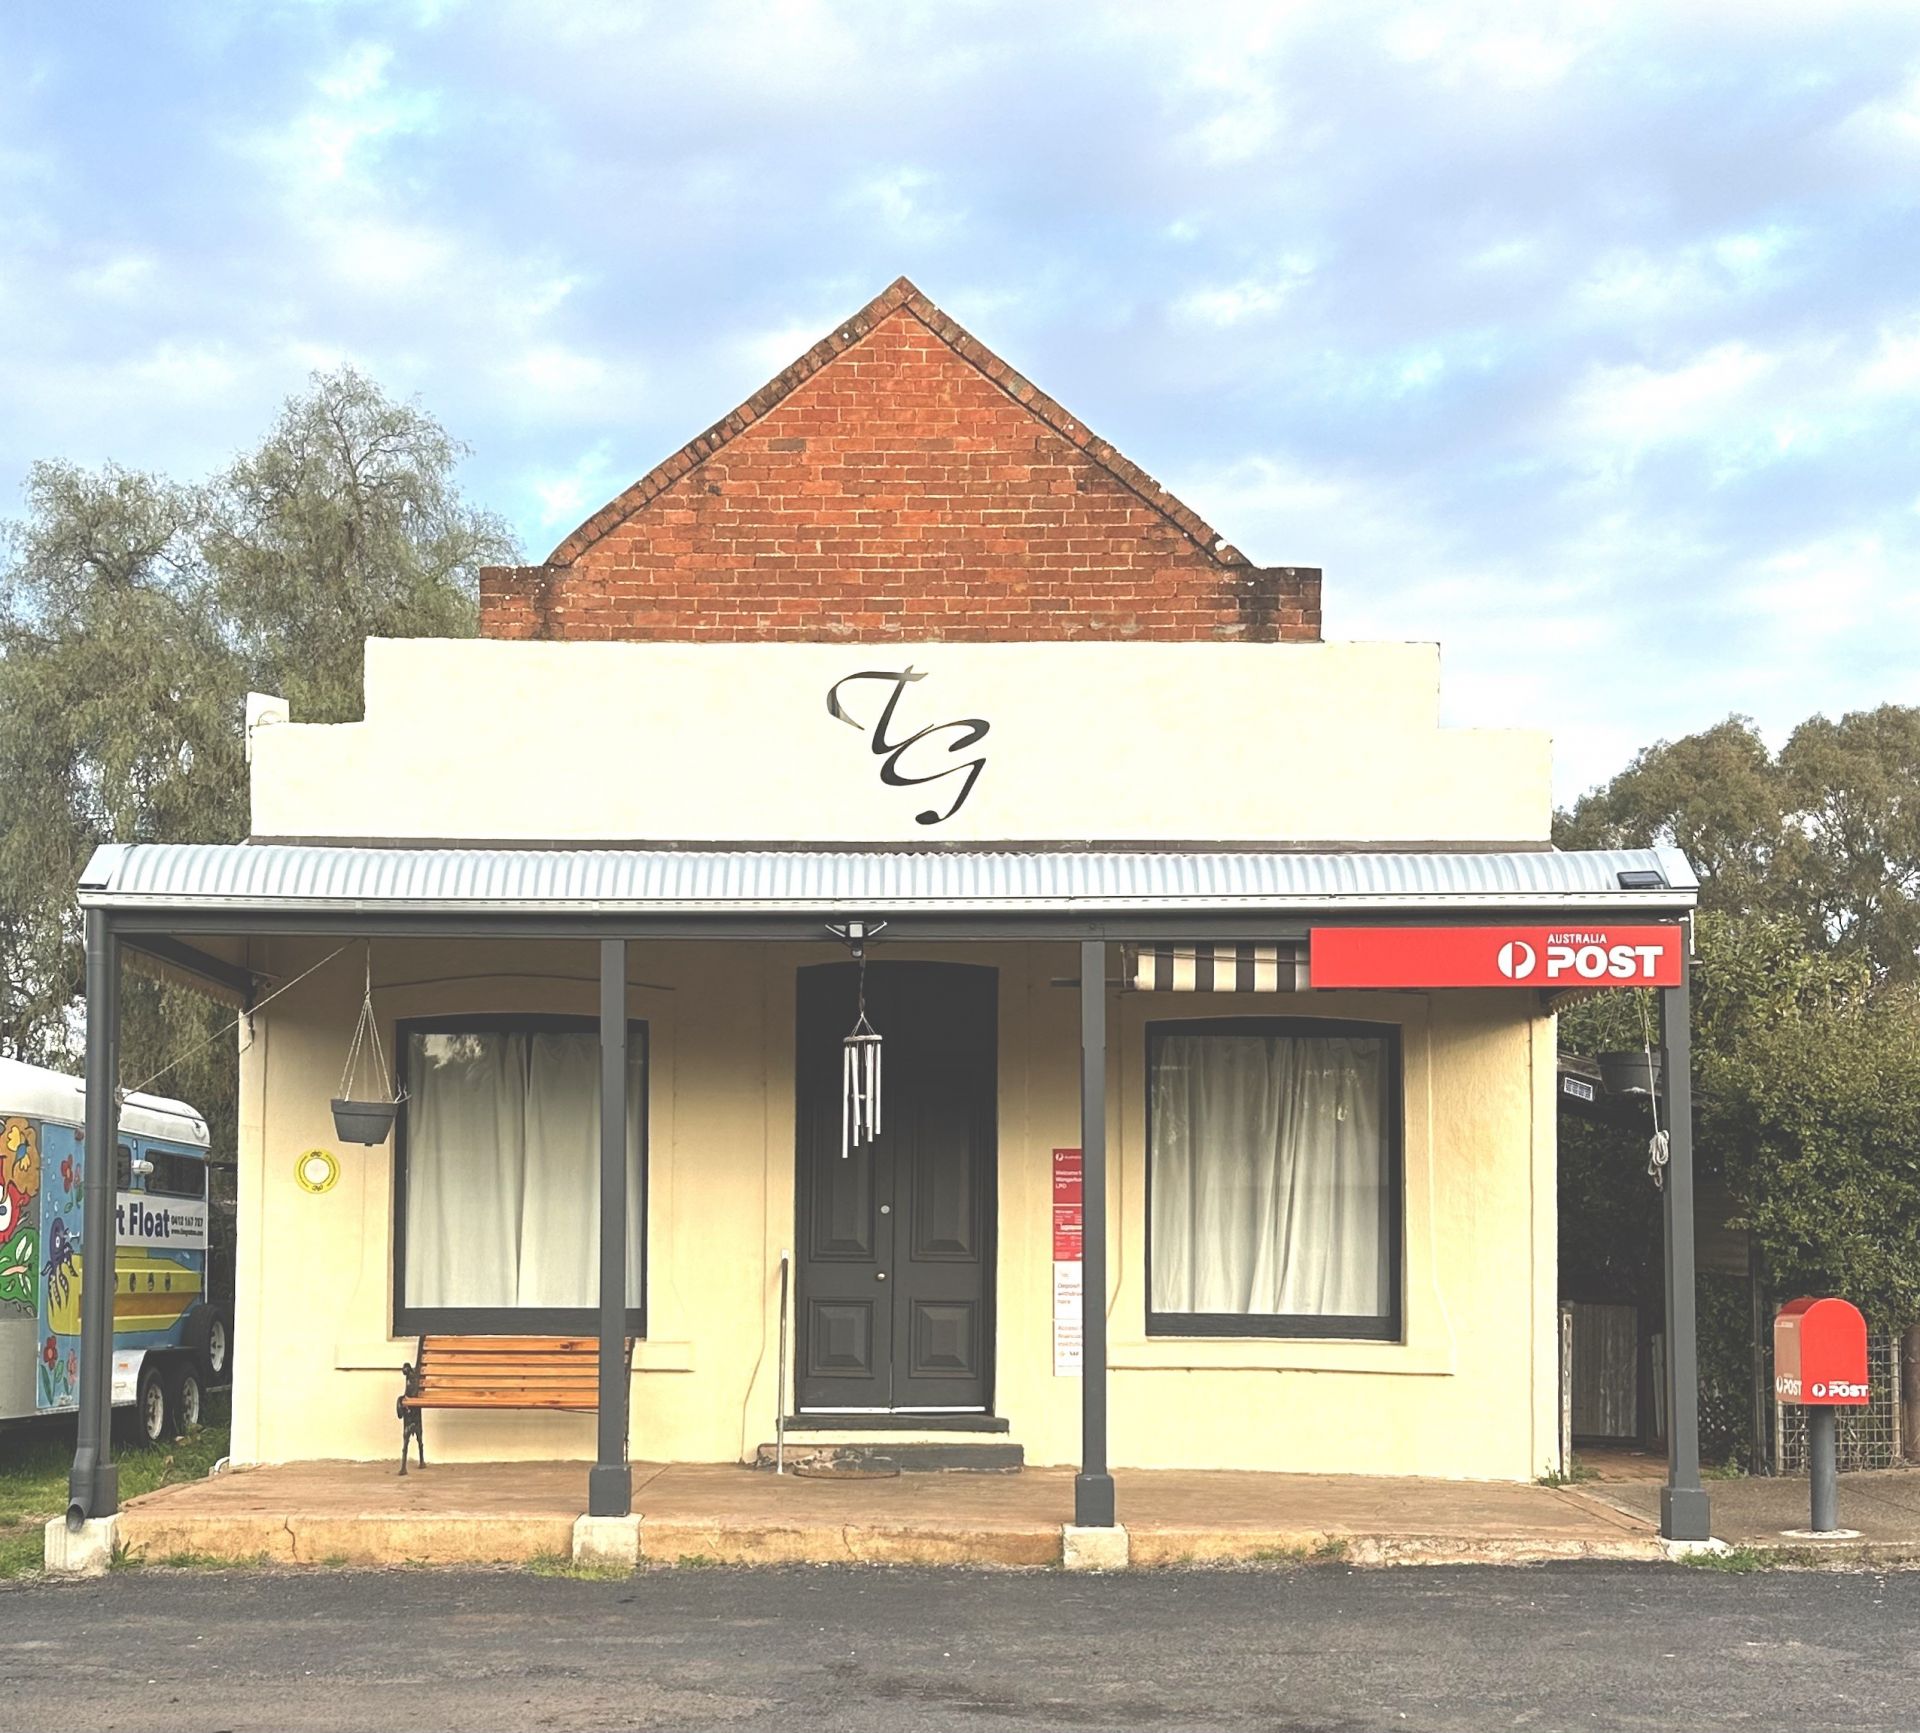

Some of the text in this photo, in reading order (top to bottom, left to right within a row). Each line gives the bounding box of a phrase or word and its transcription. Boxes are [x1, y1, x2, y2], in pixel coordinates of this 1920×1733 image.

[1547, 933, 1608, 944] AUSTRALIA
[1547, 945, 1664, 978] POST
[129, 1201, 170, 1238] Float
[1783, 1378, 1802, 1396] POST
[1828, 1384, 1869, 1397] POST
